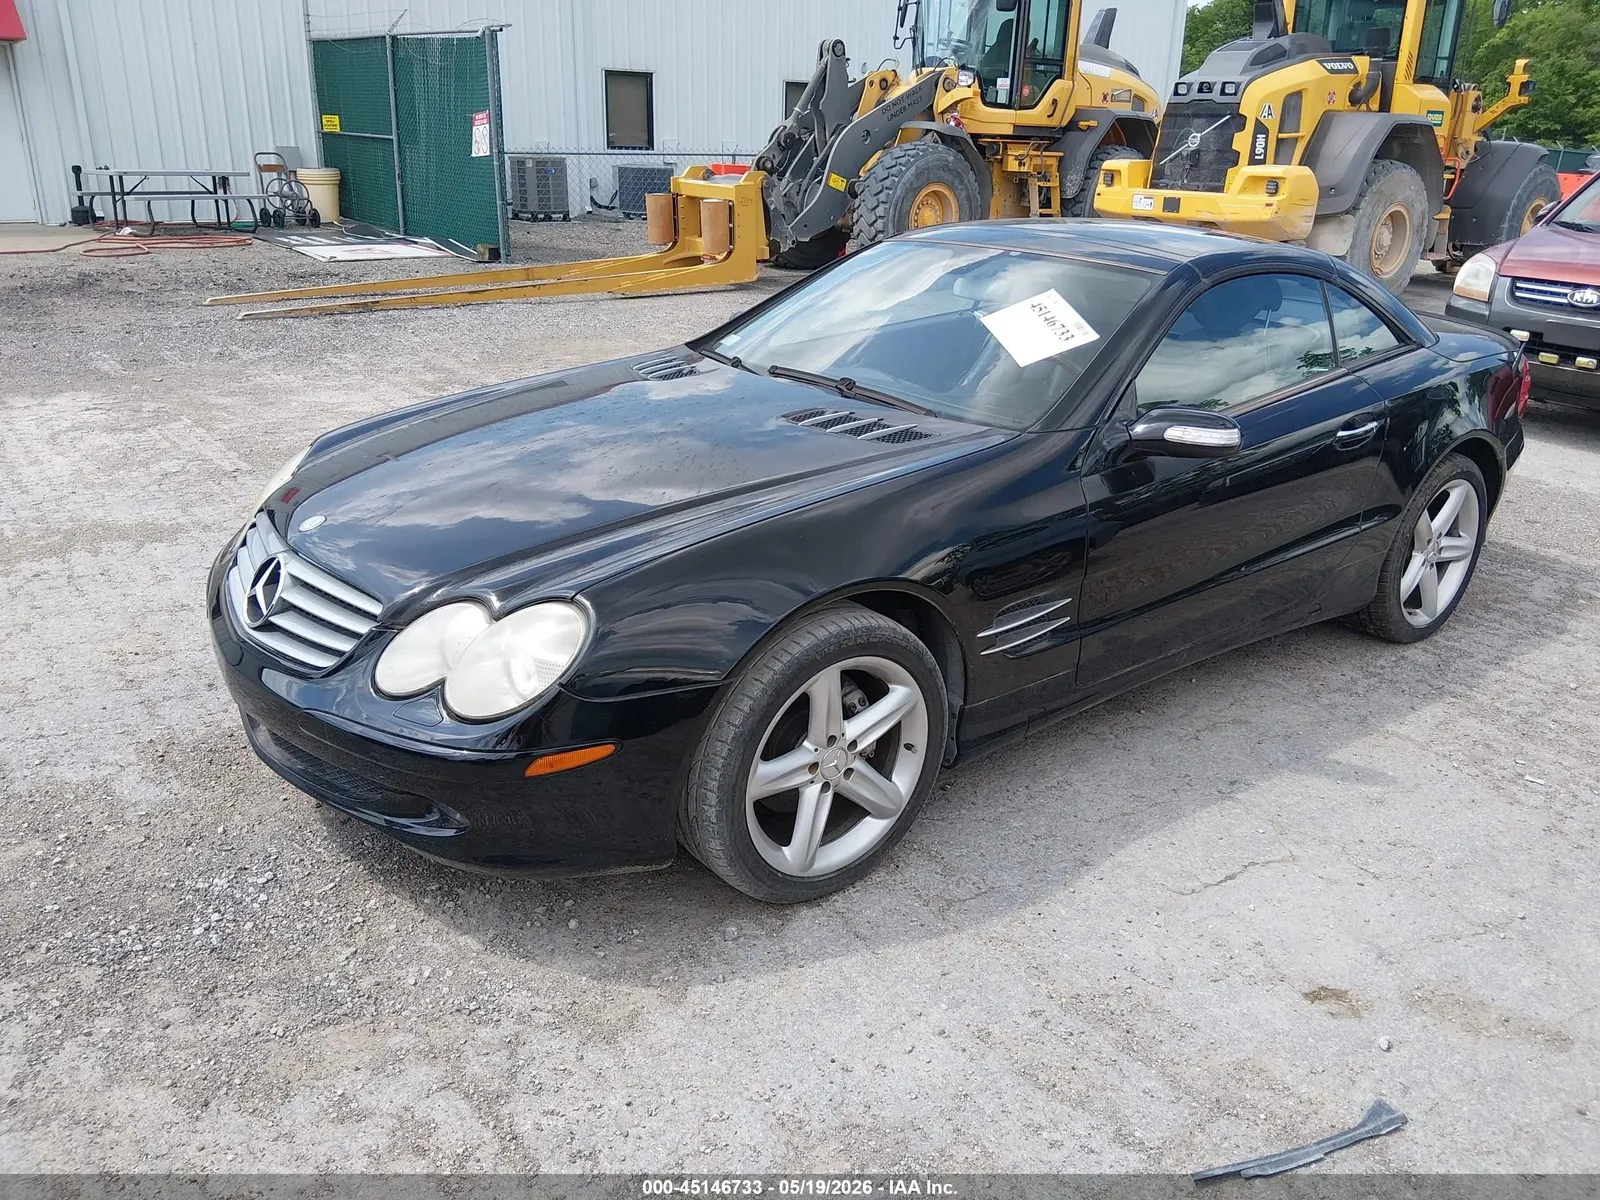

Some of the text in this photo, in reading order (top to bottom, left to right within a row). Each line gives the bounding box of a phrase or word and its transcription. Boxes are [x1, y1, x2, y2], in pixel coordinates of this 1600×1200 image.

[1322, 62, 1355, 70] VOLVO
[881, 86, 924, 115] DO NOT WALK
[887, 95, 923, 122] UNDER MAST
[1254, 134, 1266, 160] L90H
[1030, 303, 1075, 342] 45146733
